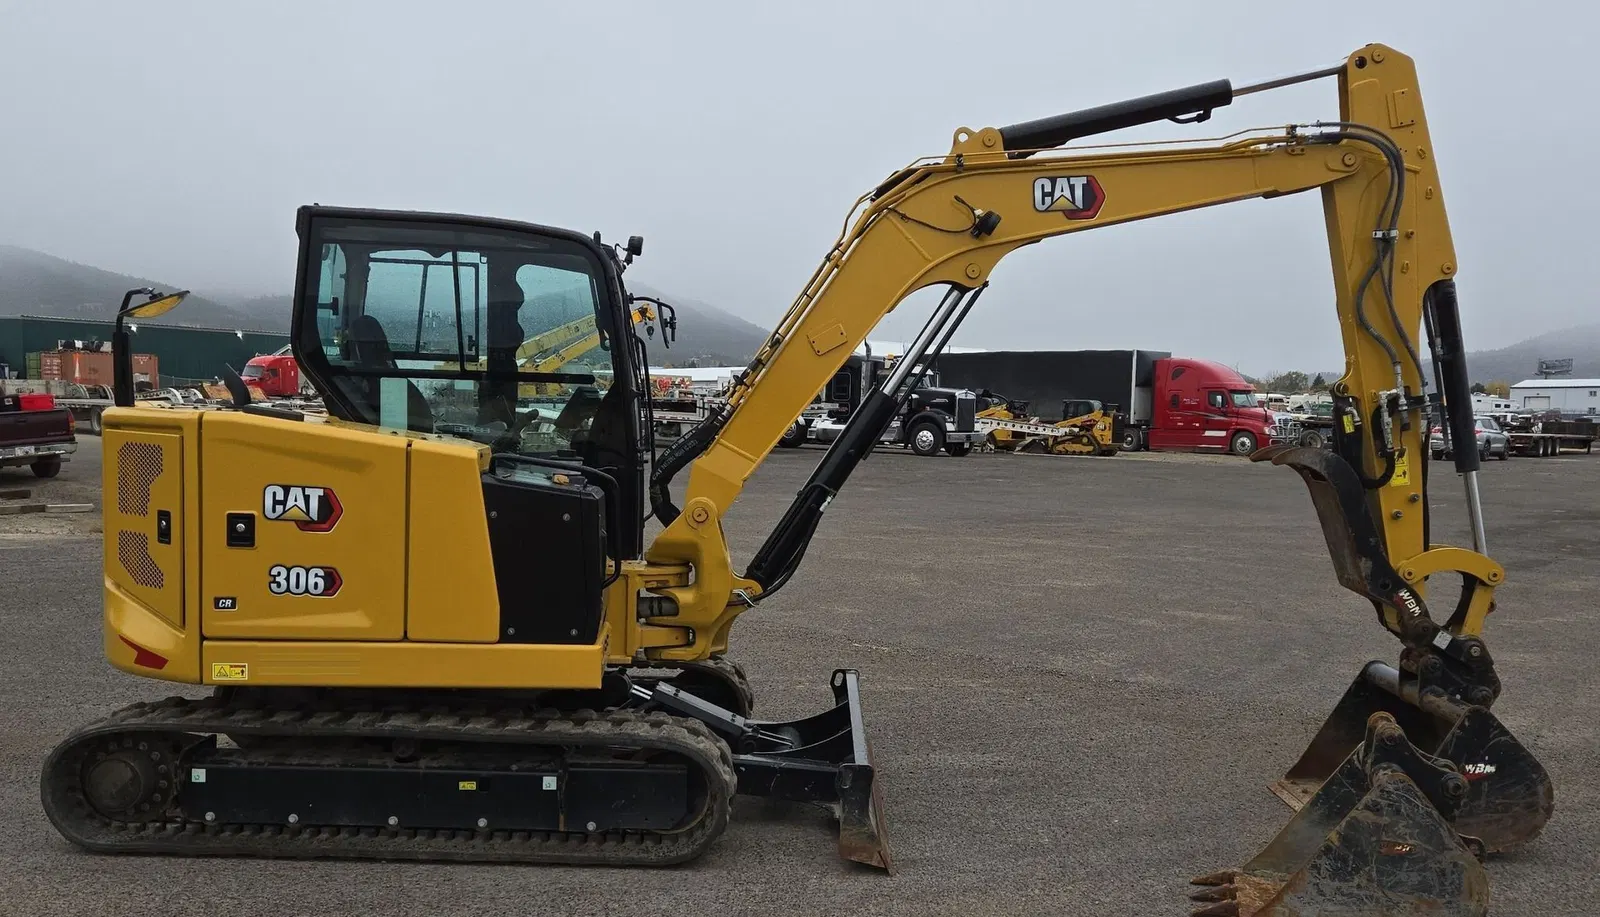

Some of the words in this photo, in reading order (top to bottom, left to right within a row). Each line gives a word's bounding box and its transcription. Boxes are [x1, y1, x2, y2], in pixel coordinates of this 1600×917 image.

[1034, 176, 1087, 211] CAT
[264, 485, 324, 521] CAT
[270, 565, 325, 595] 306
[218, 598, 233, 608] CR
[1398, 588, 1422, 617] WBM
[1465, 763, 1497, 774] WBM
